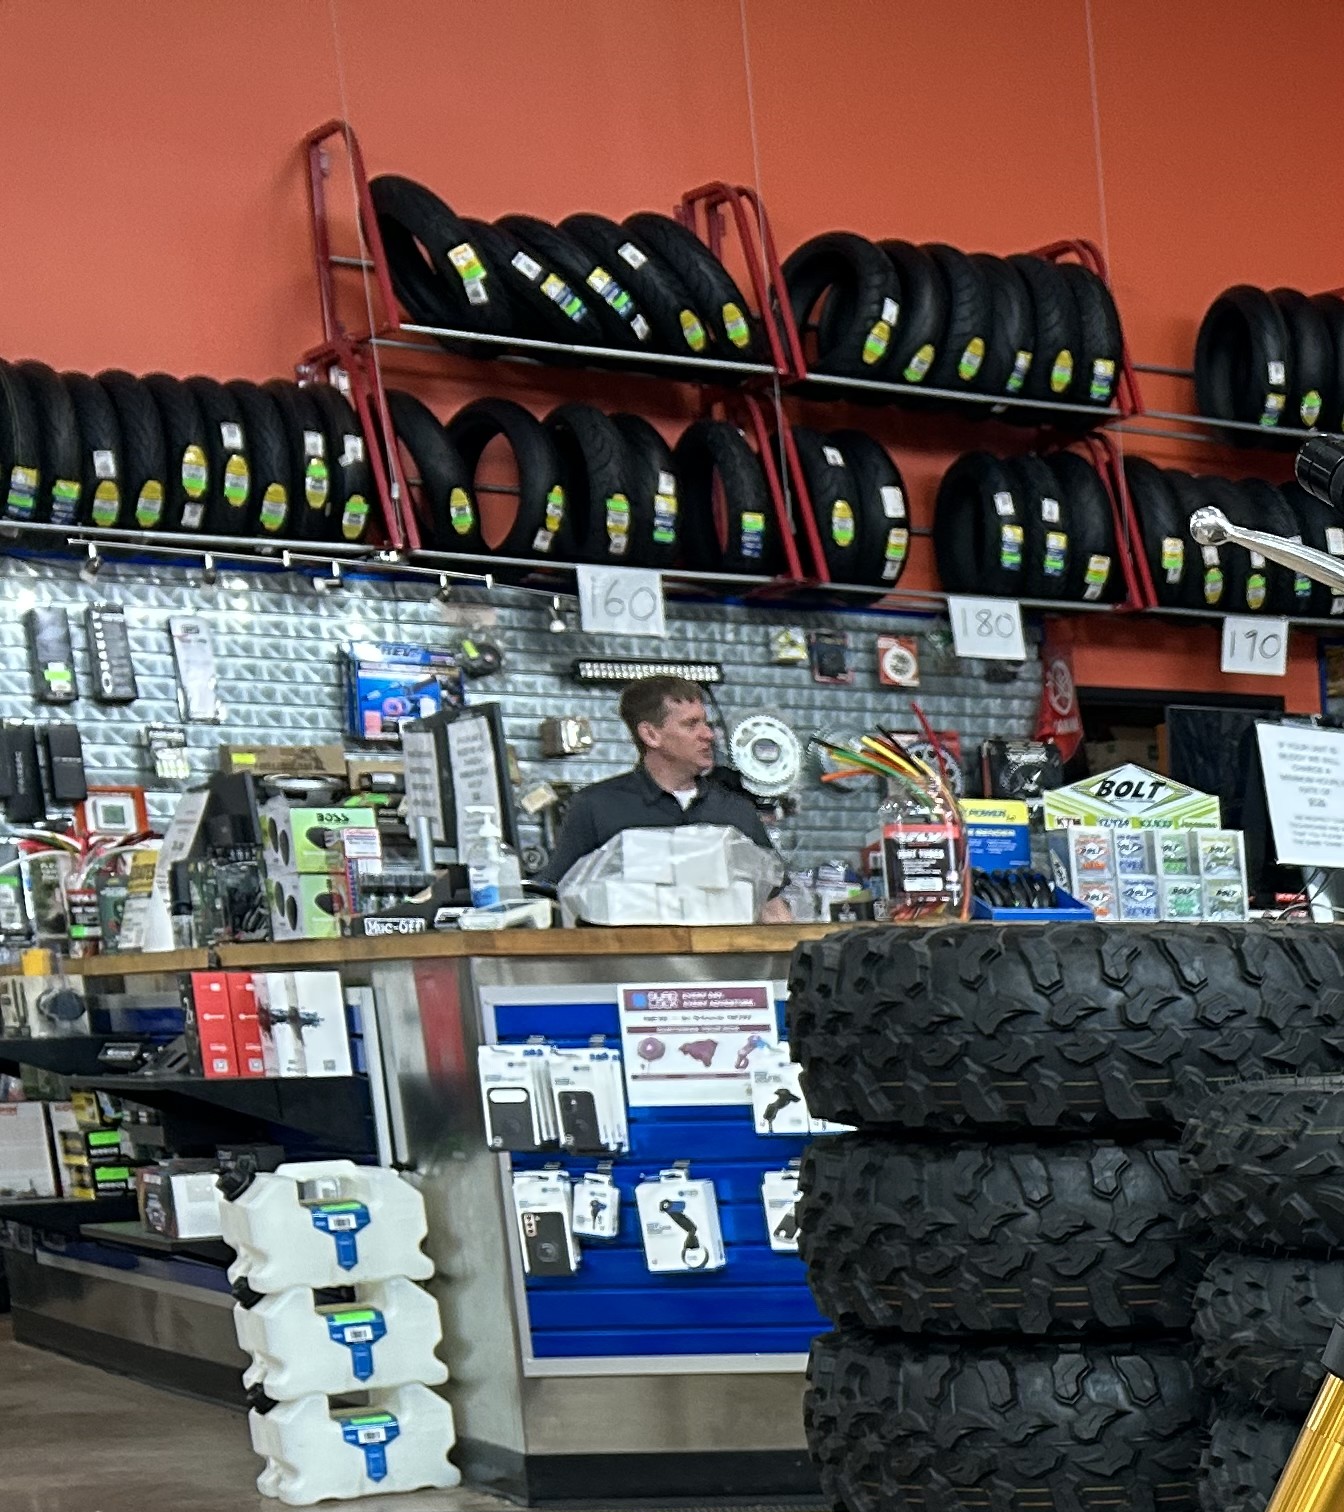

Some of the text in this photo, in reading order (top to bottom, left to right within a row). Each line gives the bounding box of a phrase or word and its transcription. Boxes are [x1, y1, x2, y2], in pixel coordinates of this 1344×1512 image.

[588, 582, 657, 622] 160
[960, 606, 1015, 640] 180
[1229, 632, 1282, 662] 190
[1095, 780, 1166, 798] BOLT
